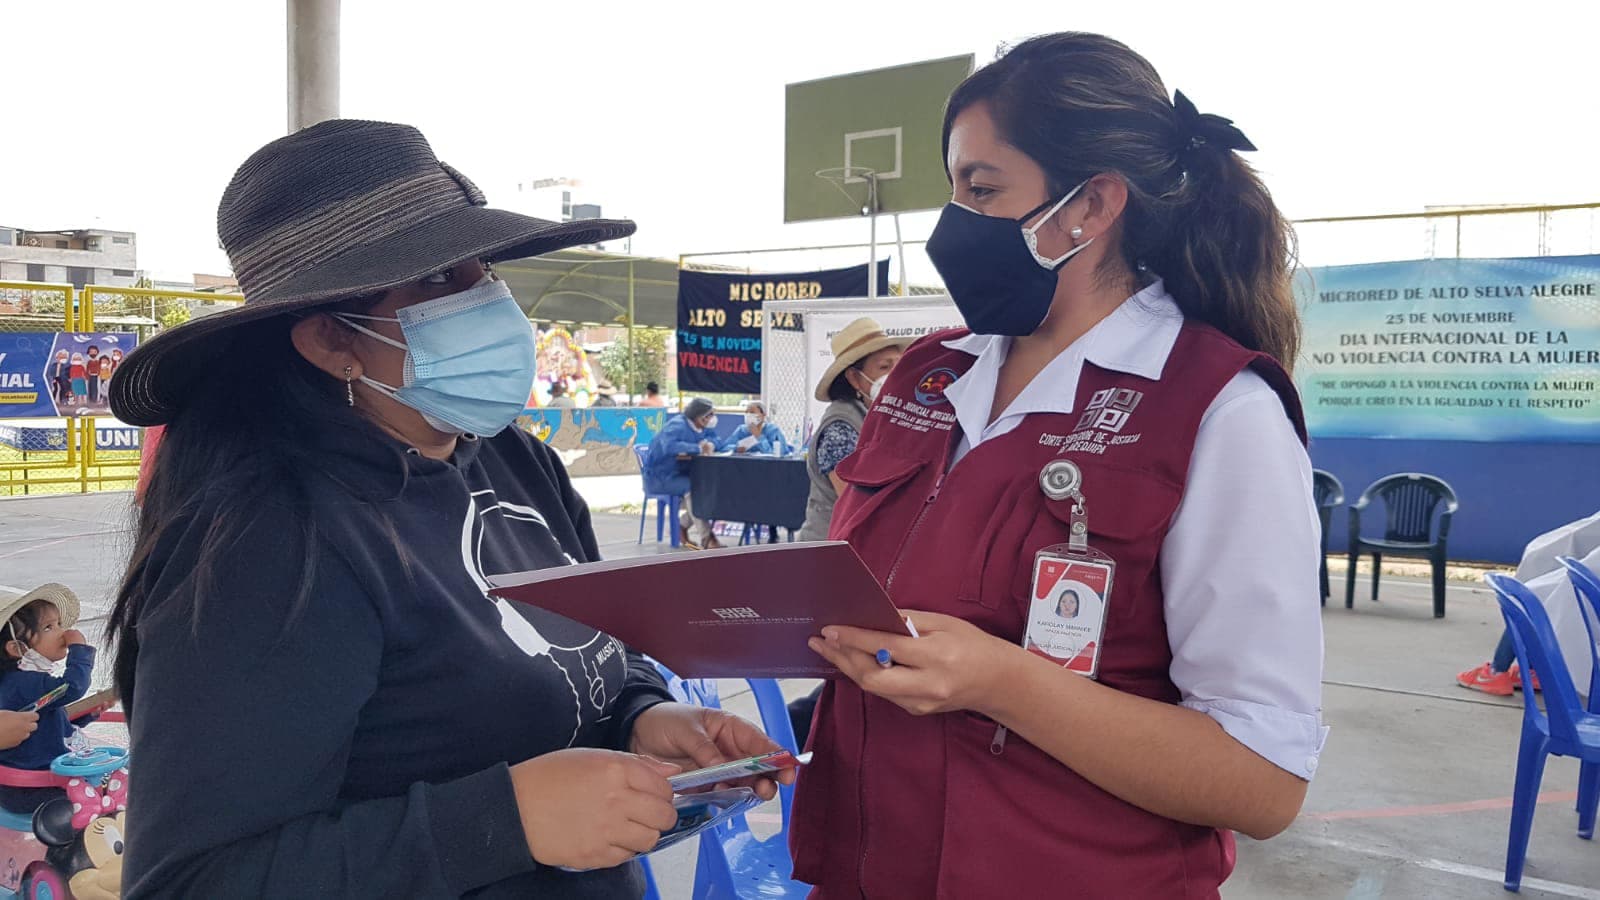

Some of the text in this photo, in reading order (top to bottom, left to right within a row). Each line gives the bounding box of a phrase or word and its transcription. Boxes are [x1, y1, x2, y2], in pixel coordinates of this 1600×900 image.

[729, 281, 822, 301] MICRORED
[1319, 283, 1596, 303] MICRORED DE ALTO SELVA ALEGRE
[688, 308, 726, 327] ALTO
[1386, 311, 1516, 325] 25 DE NOVIEMBRE
[886, 327, 912, 336] SALUD
[914, 327, 925, 335] DE
[1340, 331, 1569, 347] DIA INTERNACIONAL DE LA
[701, 335, 714, 349] DE
[717, 336, 761, 351] NOVIEM
[679, 351, 750, 374] VIOLENCIA
[1312, 351, 1600, 365] NO VIOLENCIA CONTRA LA MUJER
[0, 373, 35, 388] IAL
[1341, 380, 1387, 390] OPONGO
[1389, 380, 1400, 389] A
[1401, 380, 1415, 389] LA
[1418, 380, 1478, 390] VIOLENCIA
[1481, 381, 1530, 391] CONTRA
[1534, 381, 1549, 391] LA
[1552, 381, 1595, 391] MUJER
[1318, 396, 1591, 409] PORQUE CREO EN LA IGUALDAD Y EL RESPETO"
[595, 641, 615, 665] MUSIC
